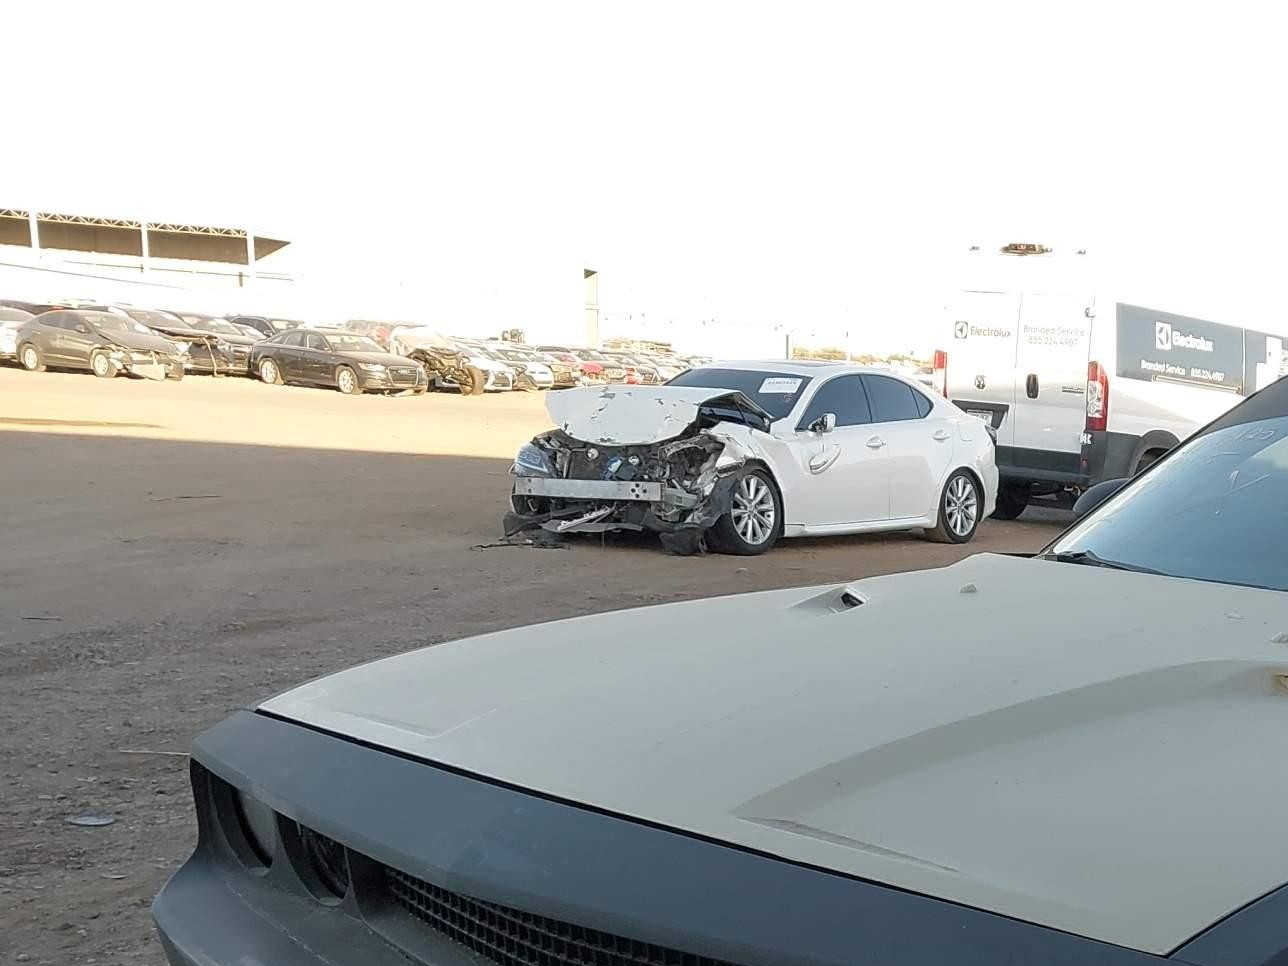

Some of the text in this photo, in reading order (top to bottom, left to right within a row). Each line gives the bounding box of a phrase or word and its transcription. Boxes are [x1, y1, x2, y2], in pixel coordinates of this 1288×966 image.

[970, 326, 1012, 338] Electrolux
[1172, 331, 1215, 352] Electrolux
[1140, 359, 1165, 372] Branded
